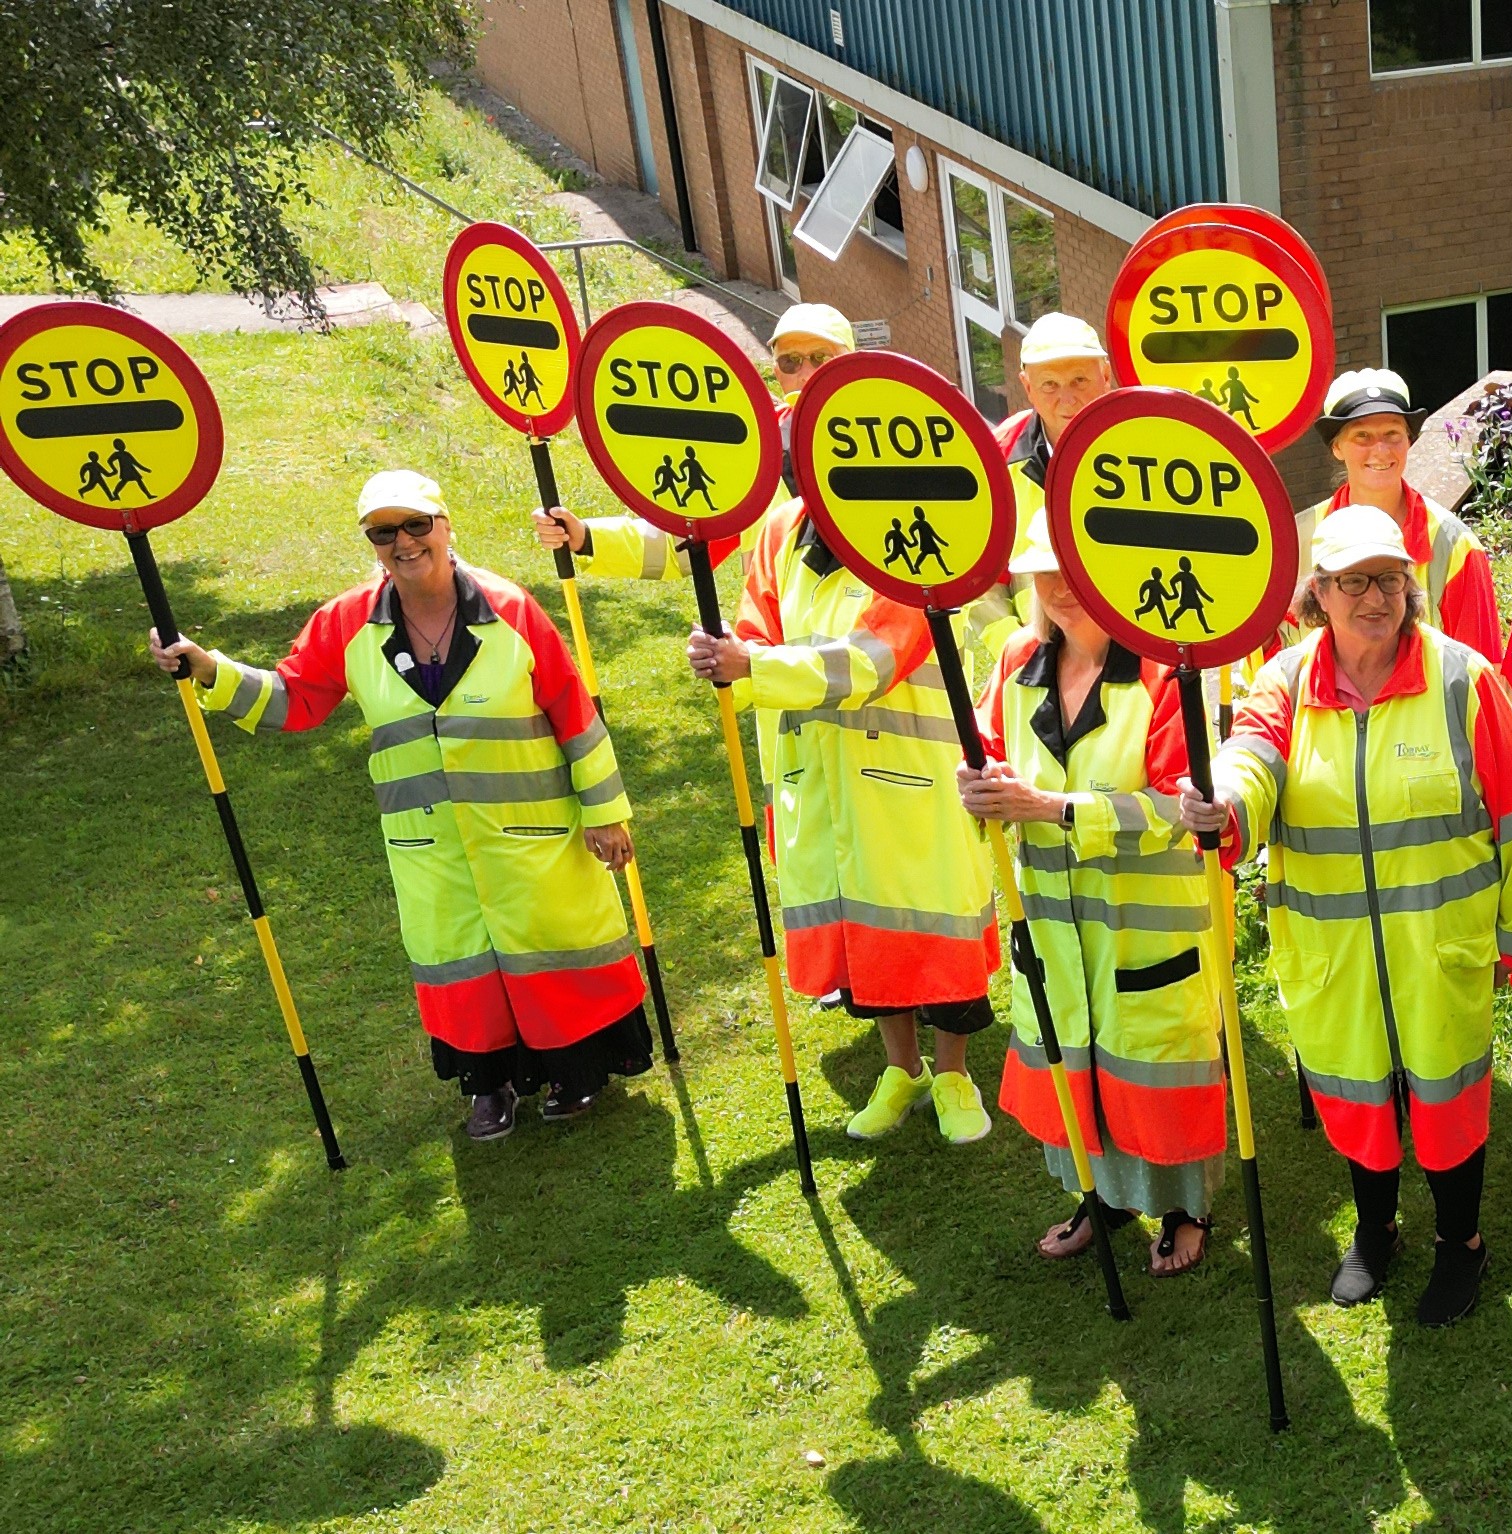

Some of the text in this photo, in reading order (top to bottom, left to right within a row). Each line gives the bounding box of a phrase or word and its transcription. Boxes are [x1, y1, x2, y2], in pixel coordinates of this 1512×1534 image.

[466, 273, 546, 314] STOP
[1149, 282, 1284, 325] STOP
[16, 355, 160, 402] STOP
[609, 357, 731, 404] STOP
[827, 415, 956, 460] STOP
[1093, 453, 1243, 508] STOP
